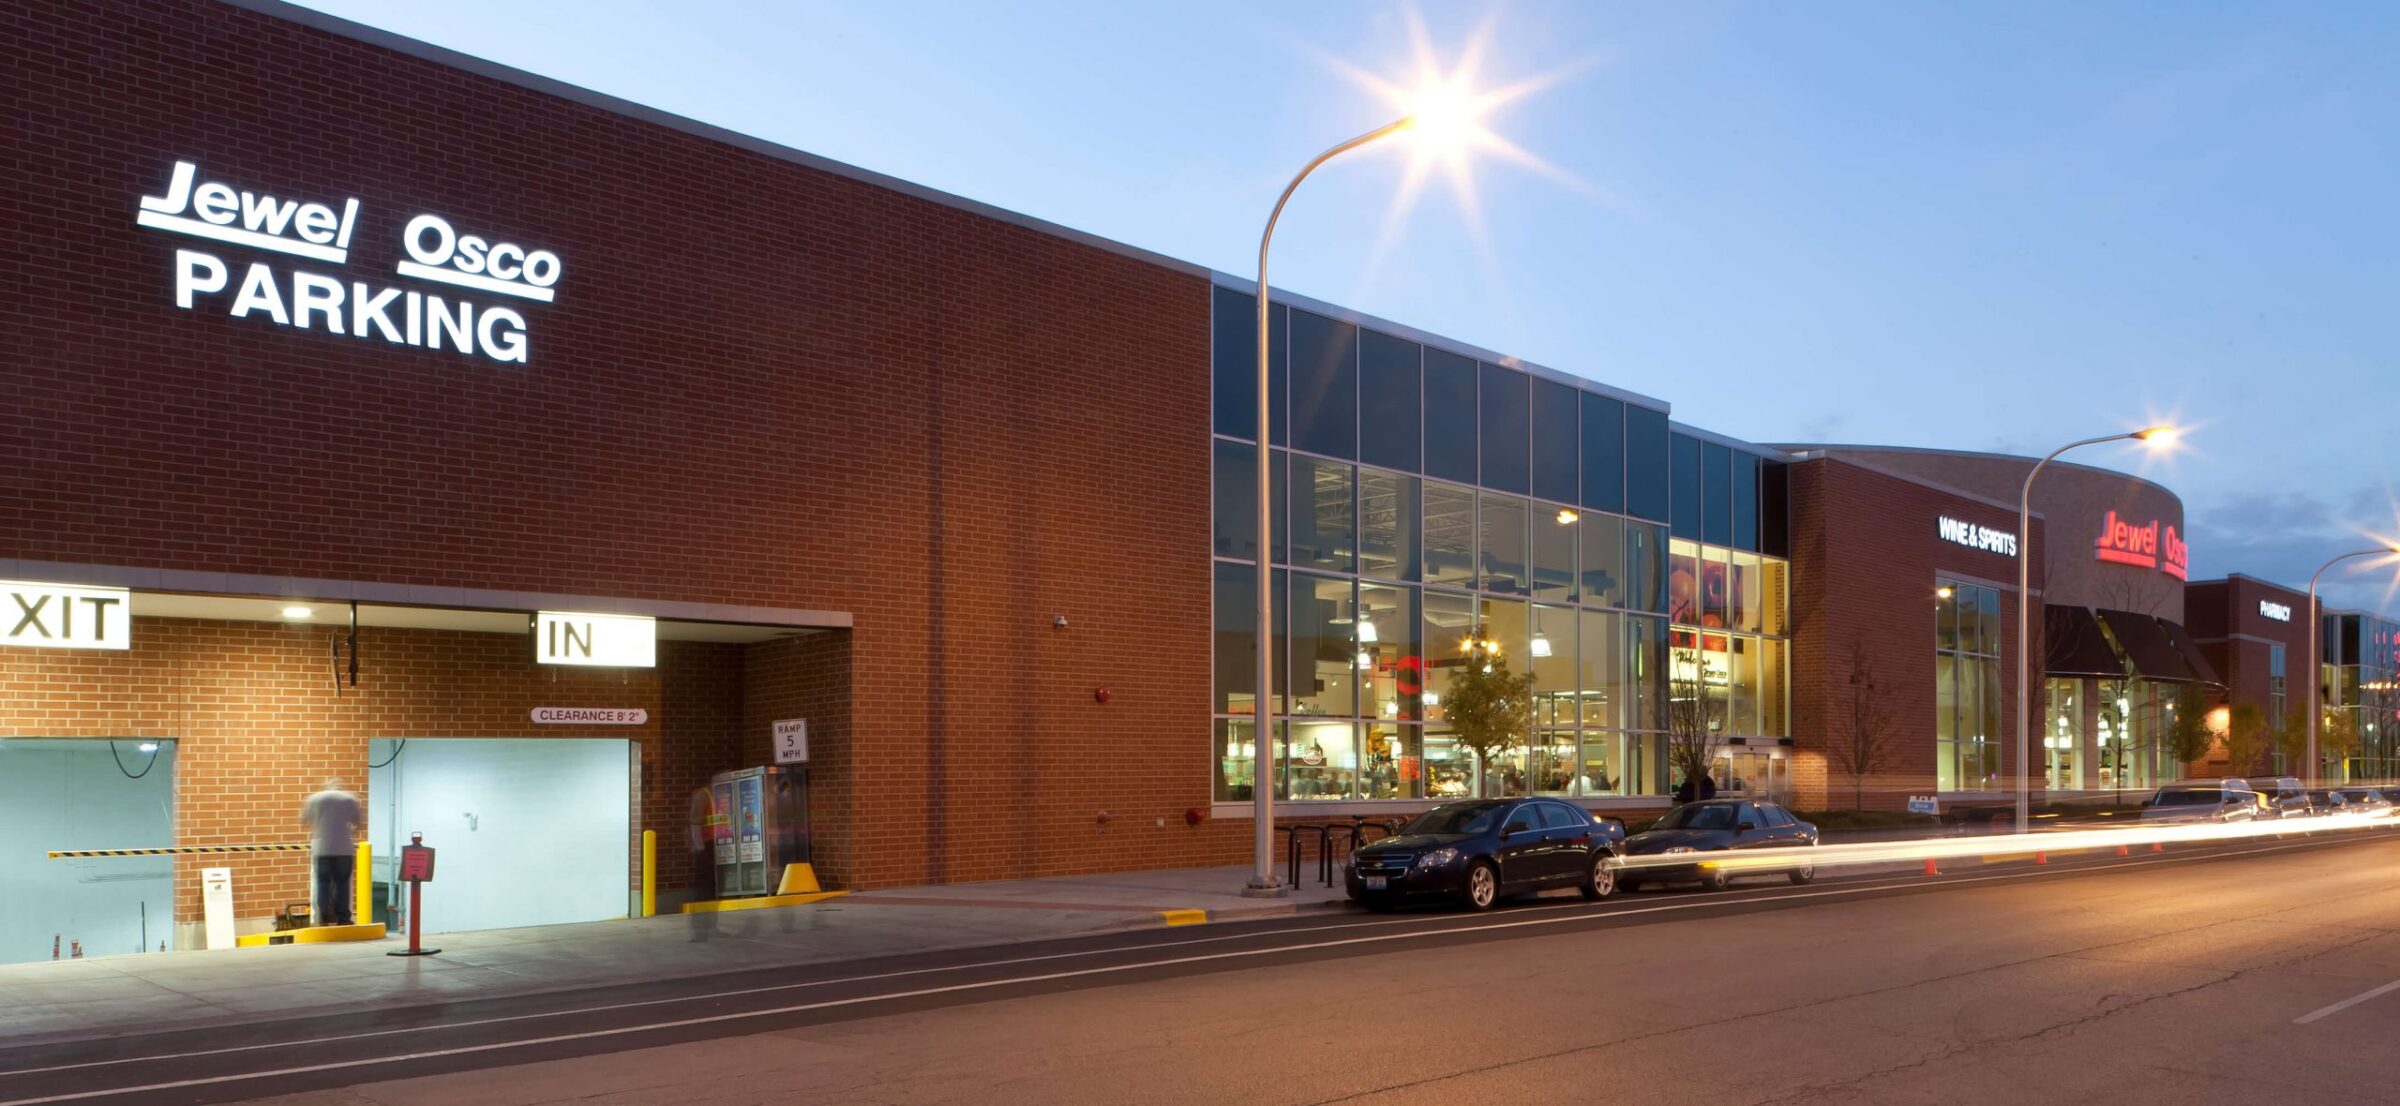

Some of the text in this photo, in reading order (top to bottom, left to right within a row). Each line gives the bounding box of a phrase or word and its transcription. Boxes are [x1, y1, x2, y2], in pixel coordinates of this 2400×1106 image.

[139, 160, 562, 288] Jewel Osco
[175, 249, 527, 364] PARKING
[1939, 515, 2017, 557] WINE & SPIRITS
[2098, 510, 2158, 556] Jewel
[7, 592, 121, 642] XIT
[549, 620, 592, 658] IN
[540, 709, 614, 721] CLEARANCE
[616, 711, 627, 721] 8'
[778, 723, 802, 735] RAMP
[782, 749, 801, 760] MPH
[786, 734, 795, 748] 5
